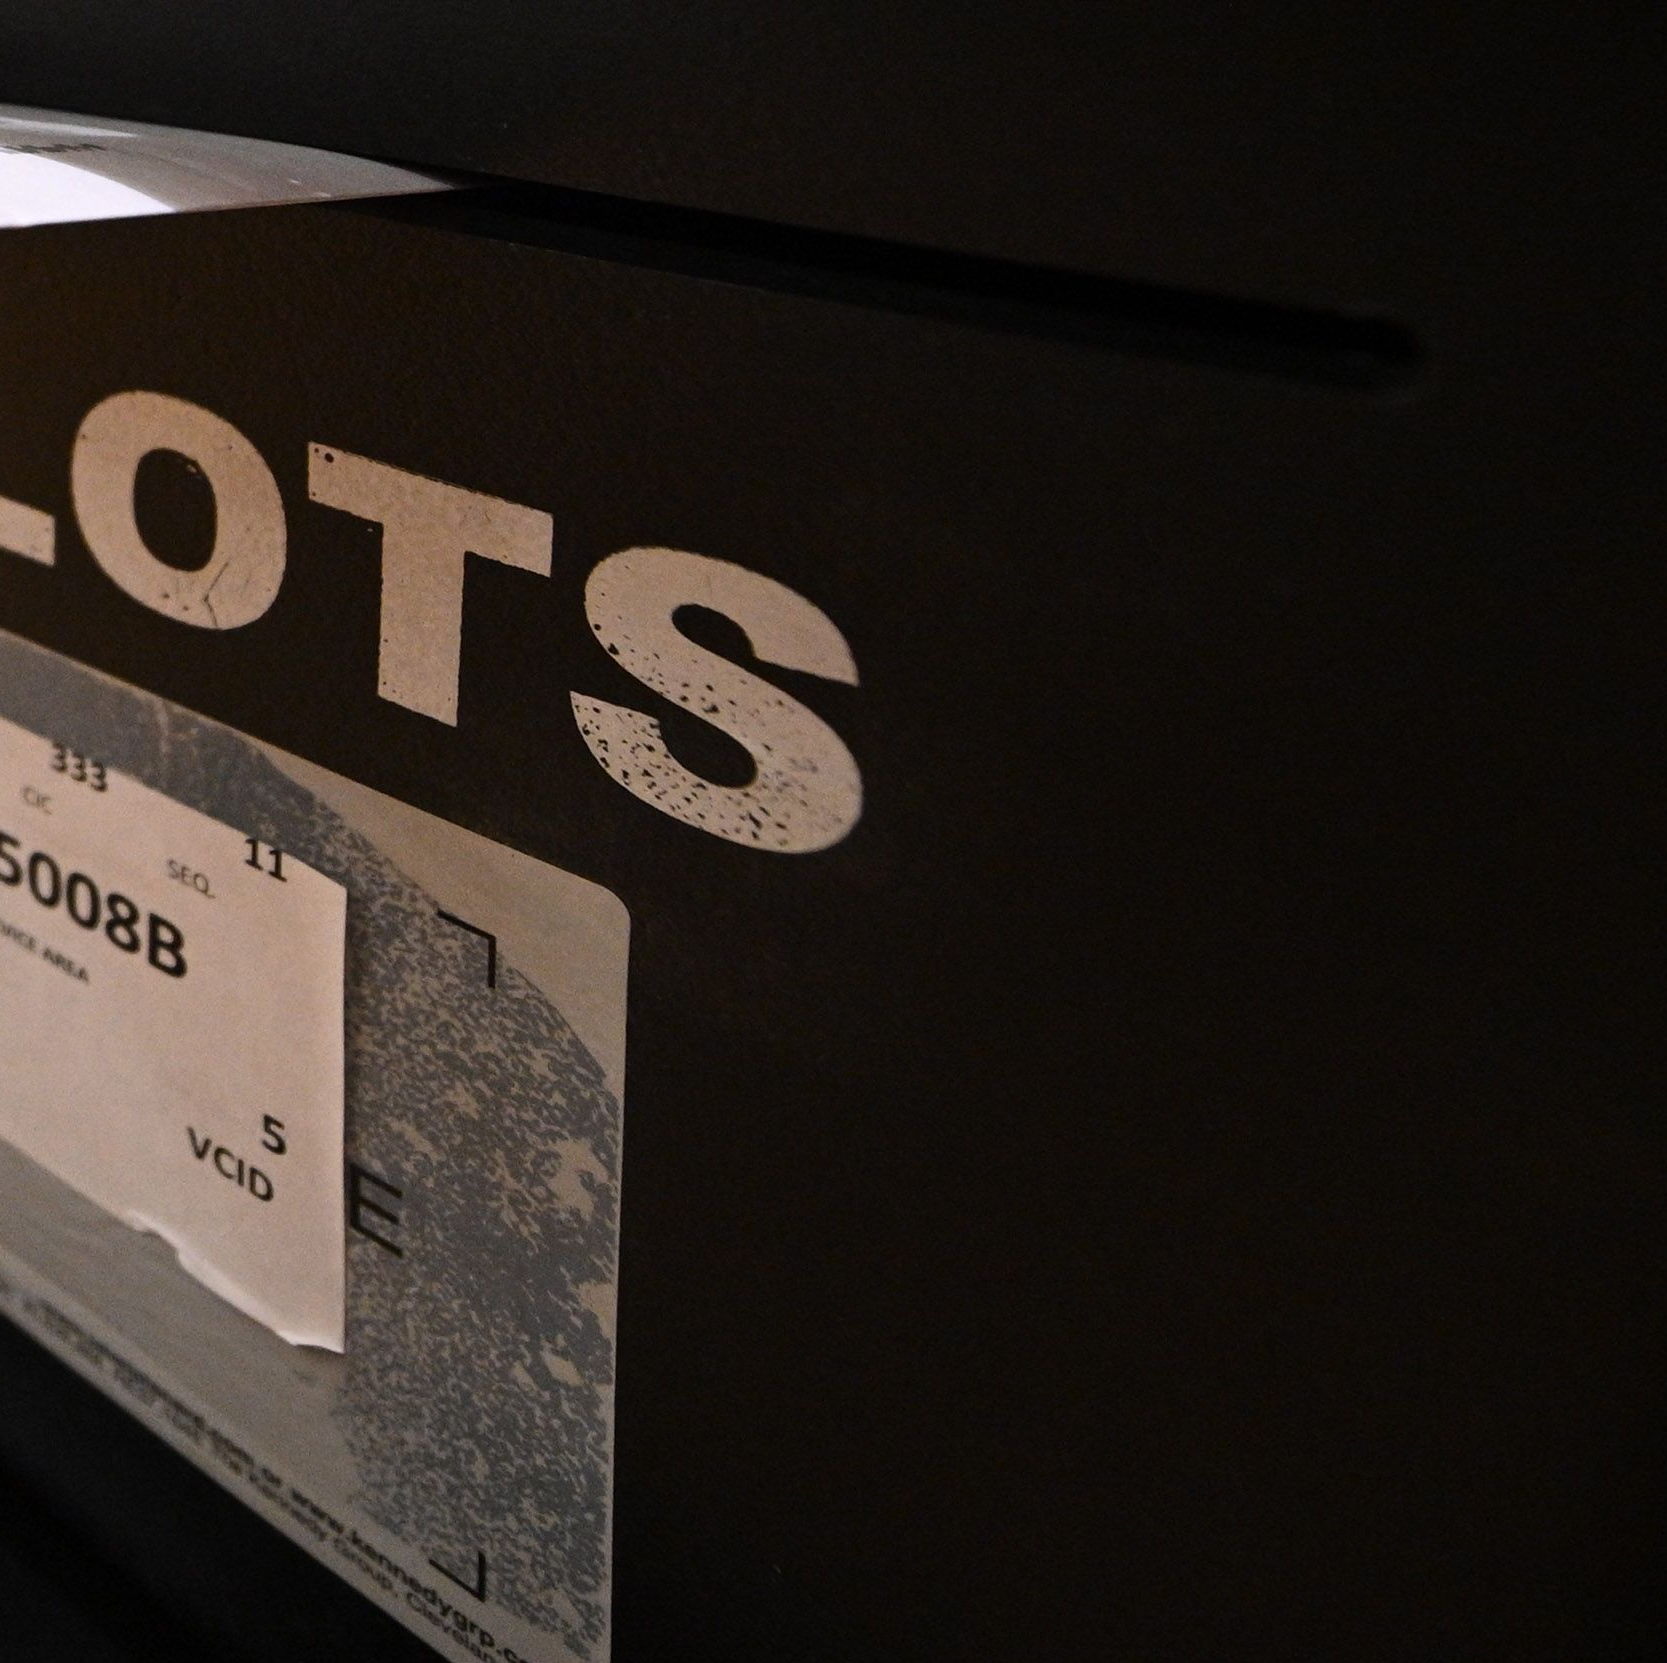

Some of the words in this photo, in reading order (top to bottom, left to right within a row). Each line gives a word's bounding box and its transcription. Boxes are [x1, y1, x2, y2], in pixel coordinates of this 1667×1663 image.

[48, 740, 108, 792] 333
[244, 837, 288, 883] 11
[41, 946, 91, 988] AREA
[261, 1112, 287, 1156] 5
[185, 1124, 275, 1203] VCID
